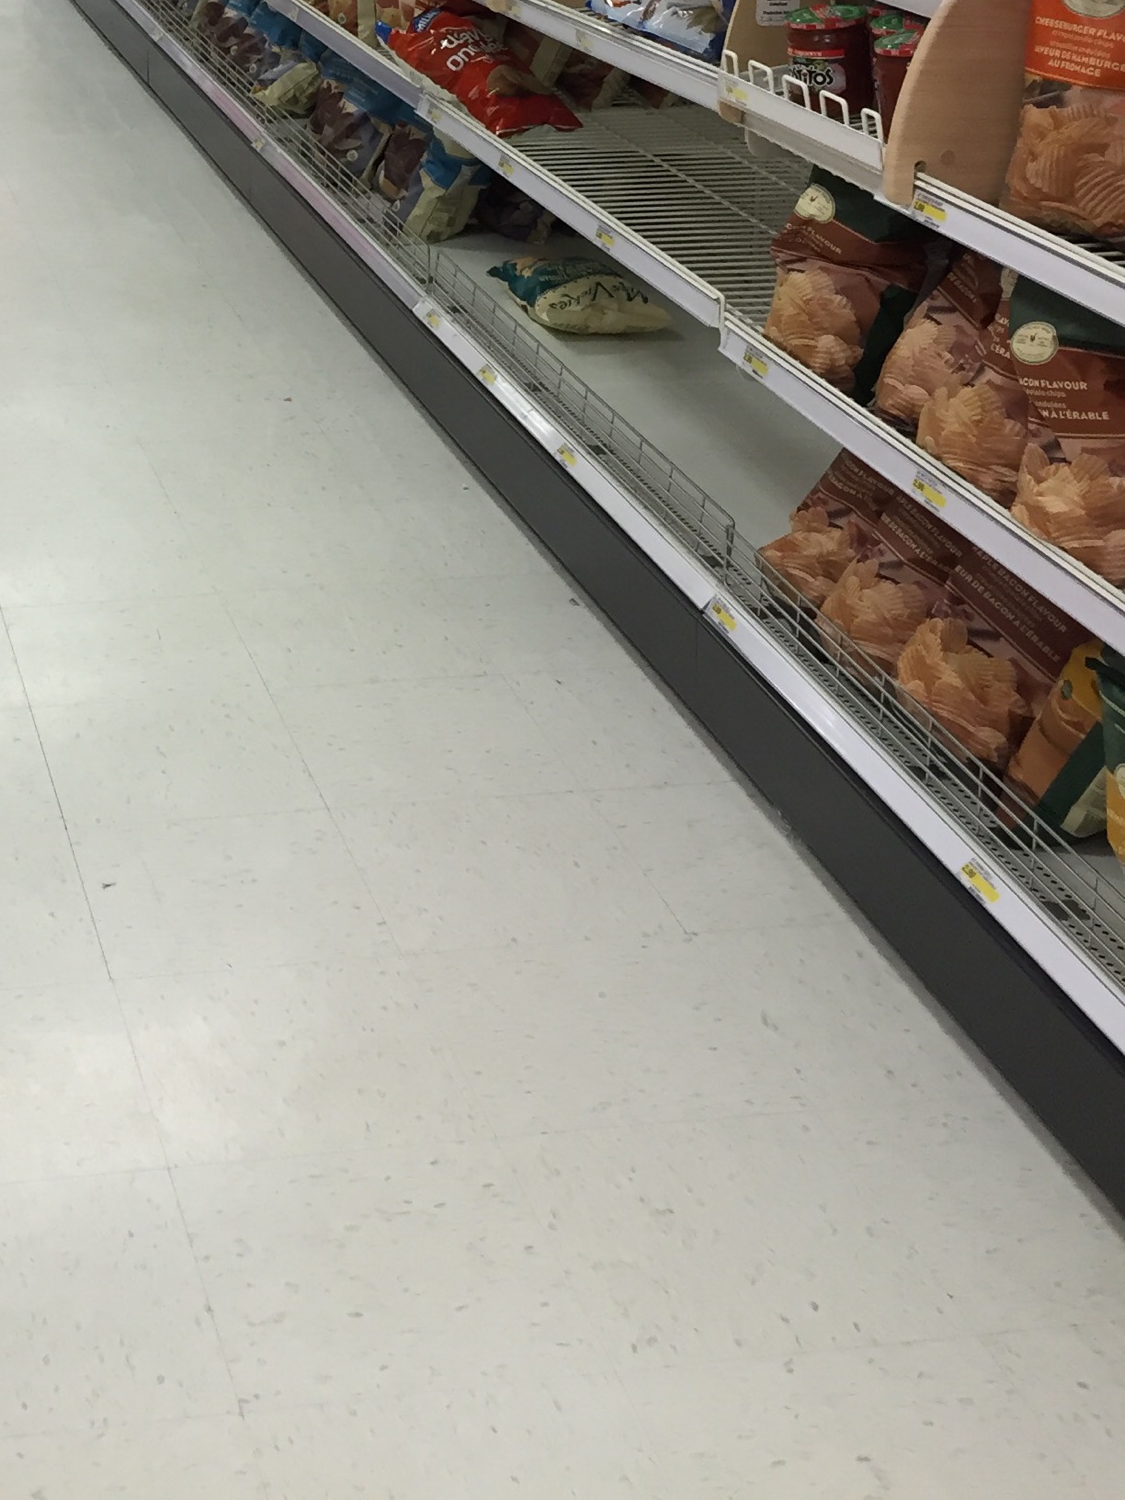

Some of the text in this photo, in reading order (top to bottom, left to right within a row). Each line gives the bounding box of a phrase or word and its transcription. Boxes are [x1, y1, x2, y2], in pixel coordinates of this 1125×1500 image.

[1035, 16, 1096, 36] CHEESEBURGER
[1041, 378, 1088, 391] FLAVOUR
[984, 592, 1013, 620] BACON
